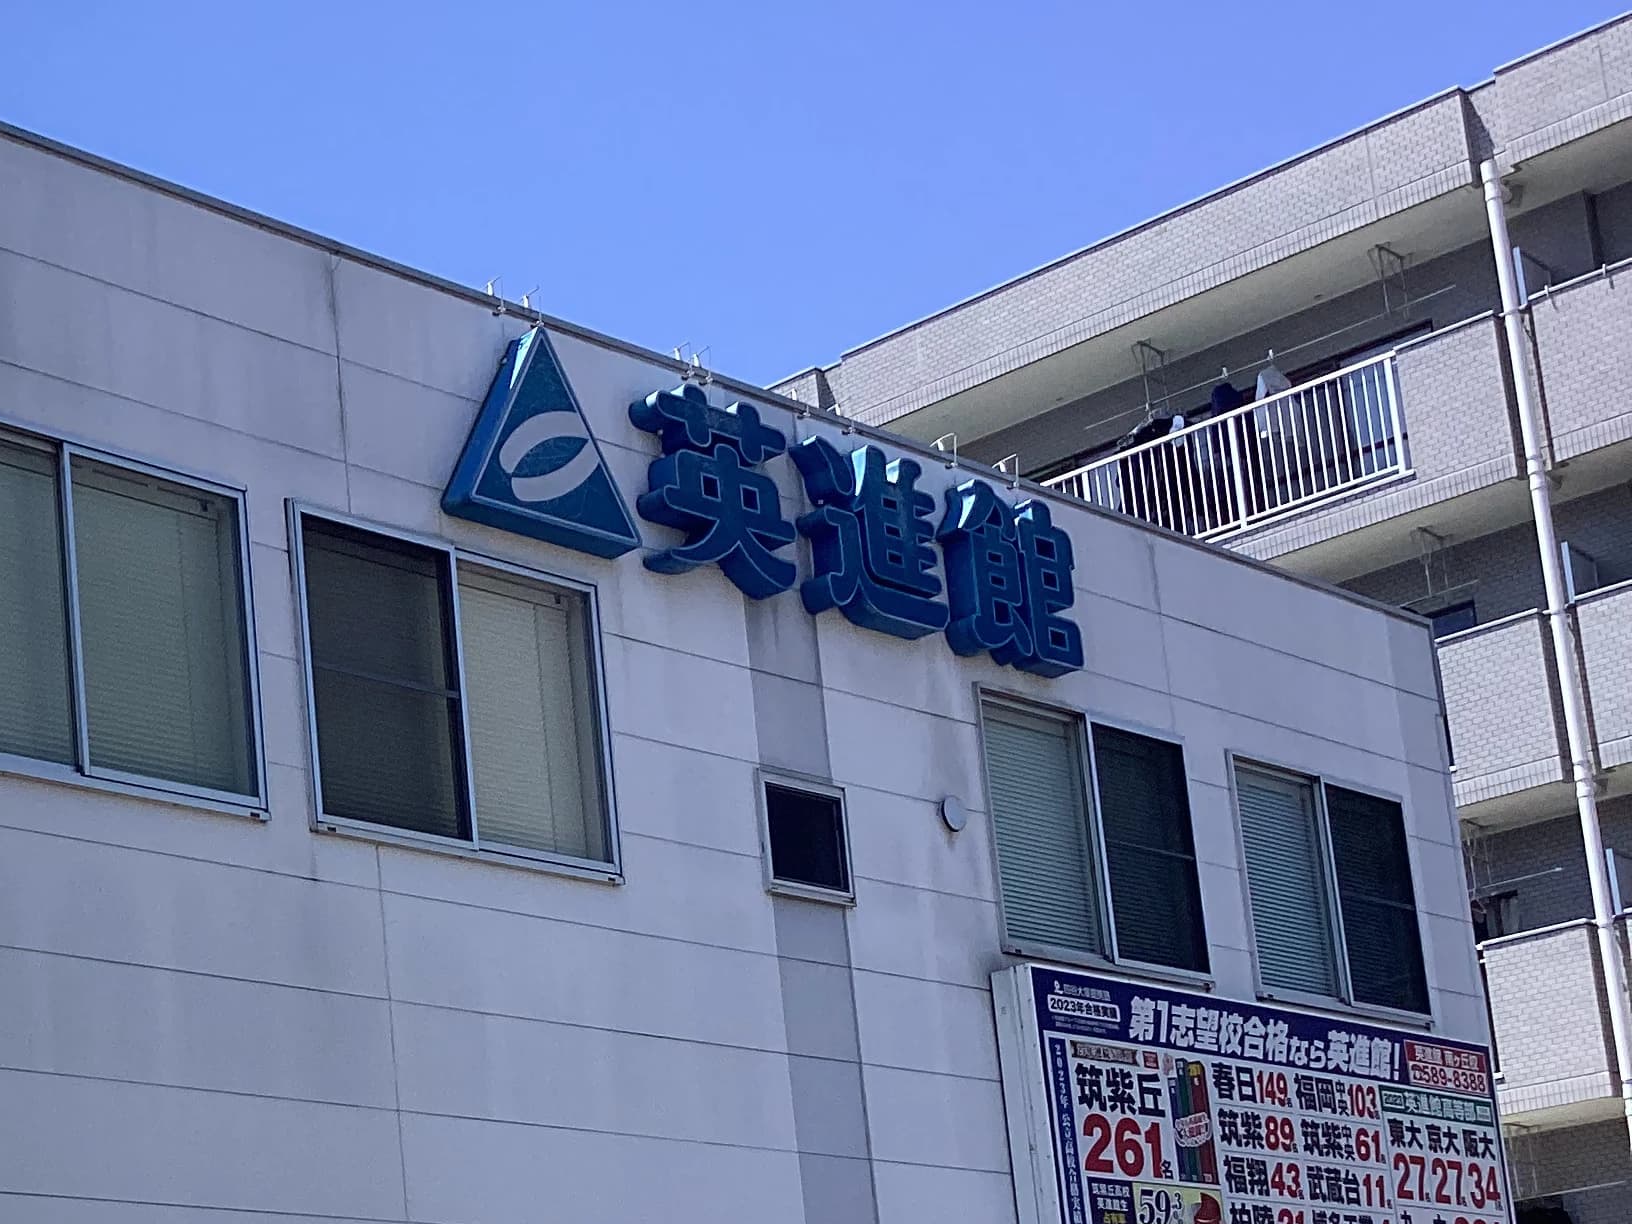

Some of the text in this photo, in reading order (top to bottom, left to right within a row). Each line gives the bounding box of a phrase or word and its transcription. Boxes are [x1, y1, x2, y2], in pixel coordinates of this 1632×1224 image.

[628, 383, 1083, 678] 英進館
[1075, 1063, 1166, 1117] 筑紫丘
[1211, 1063, 1257, 1103] 春日
